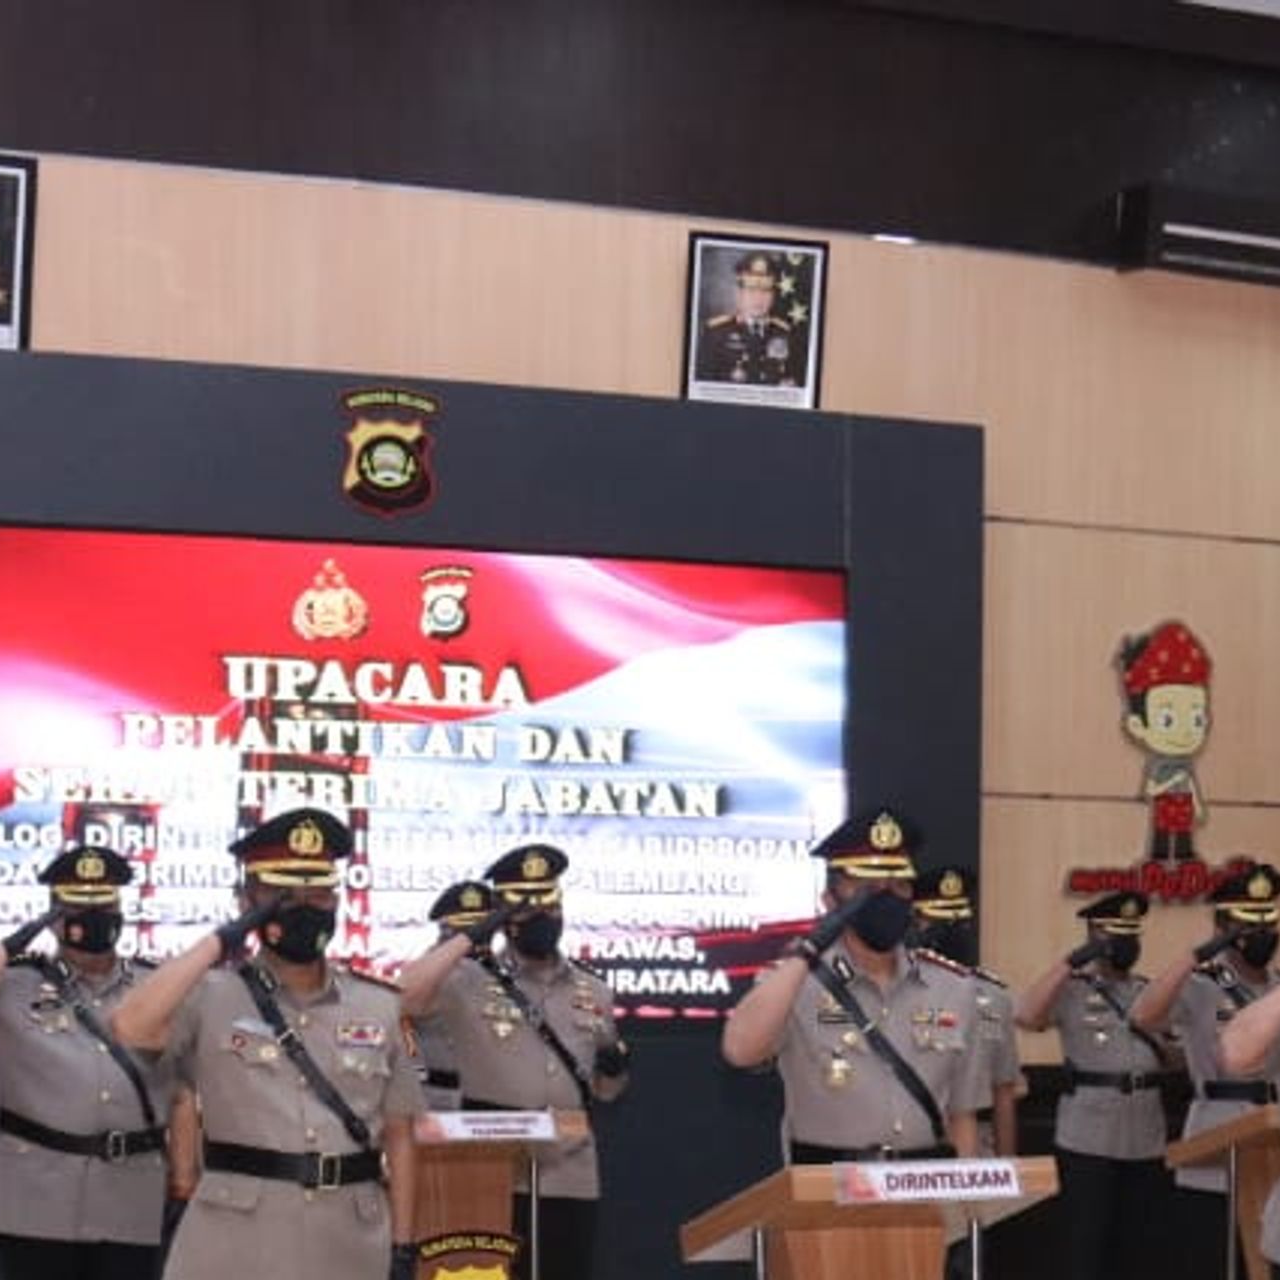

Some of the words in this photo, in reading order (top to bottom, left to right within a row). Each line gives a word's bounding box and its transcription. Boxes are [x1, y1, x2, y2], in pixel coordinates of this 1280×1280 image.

[223, 656, 530, 706] UPACARA
[120, 712, 497, 760] PELANTIKAN
[521, 724, 627, 764] DAN
[13, 767, 200, 804] SER
[478, 777, 720, 817] JABATAN
[592, 936, 705, 962] RAWAS,
[885, 1168, 1014, 1192] DIRINTELKAM
